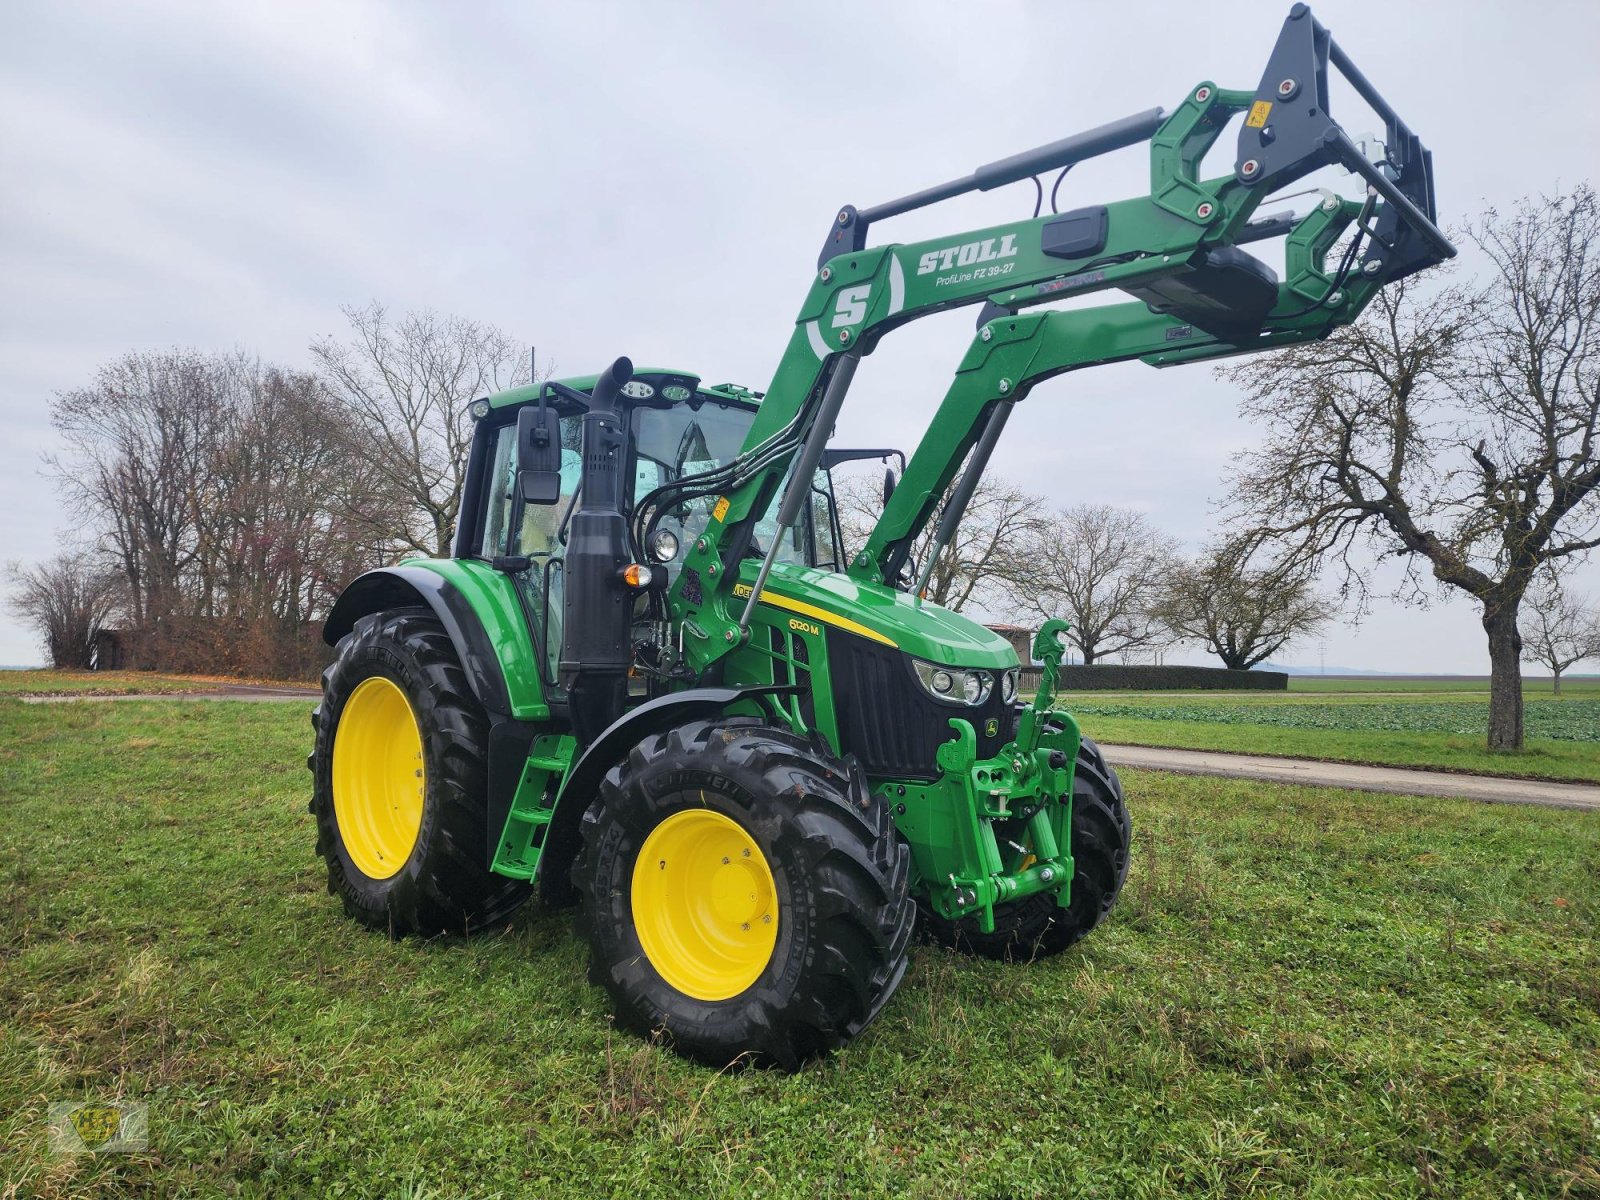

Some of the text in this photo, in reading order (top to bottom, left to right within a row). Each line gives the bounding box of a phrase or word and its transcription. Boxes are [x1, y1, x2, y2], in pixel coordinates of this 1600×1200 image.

[917, 234, 1018, 275] STOLL
[936, 263, 1015, 287] ProfiLine FZ 39-27
[832, 284, 872, 328] S
[789, 619, 819, 635] 6120 M
